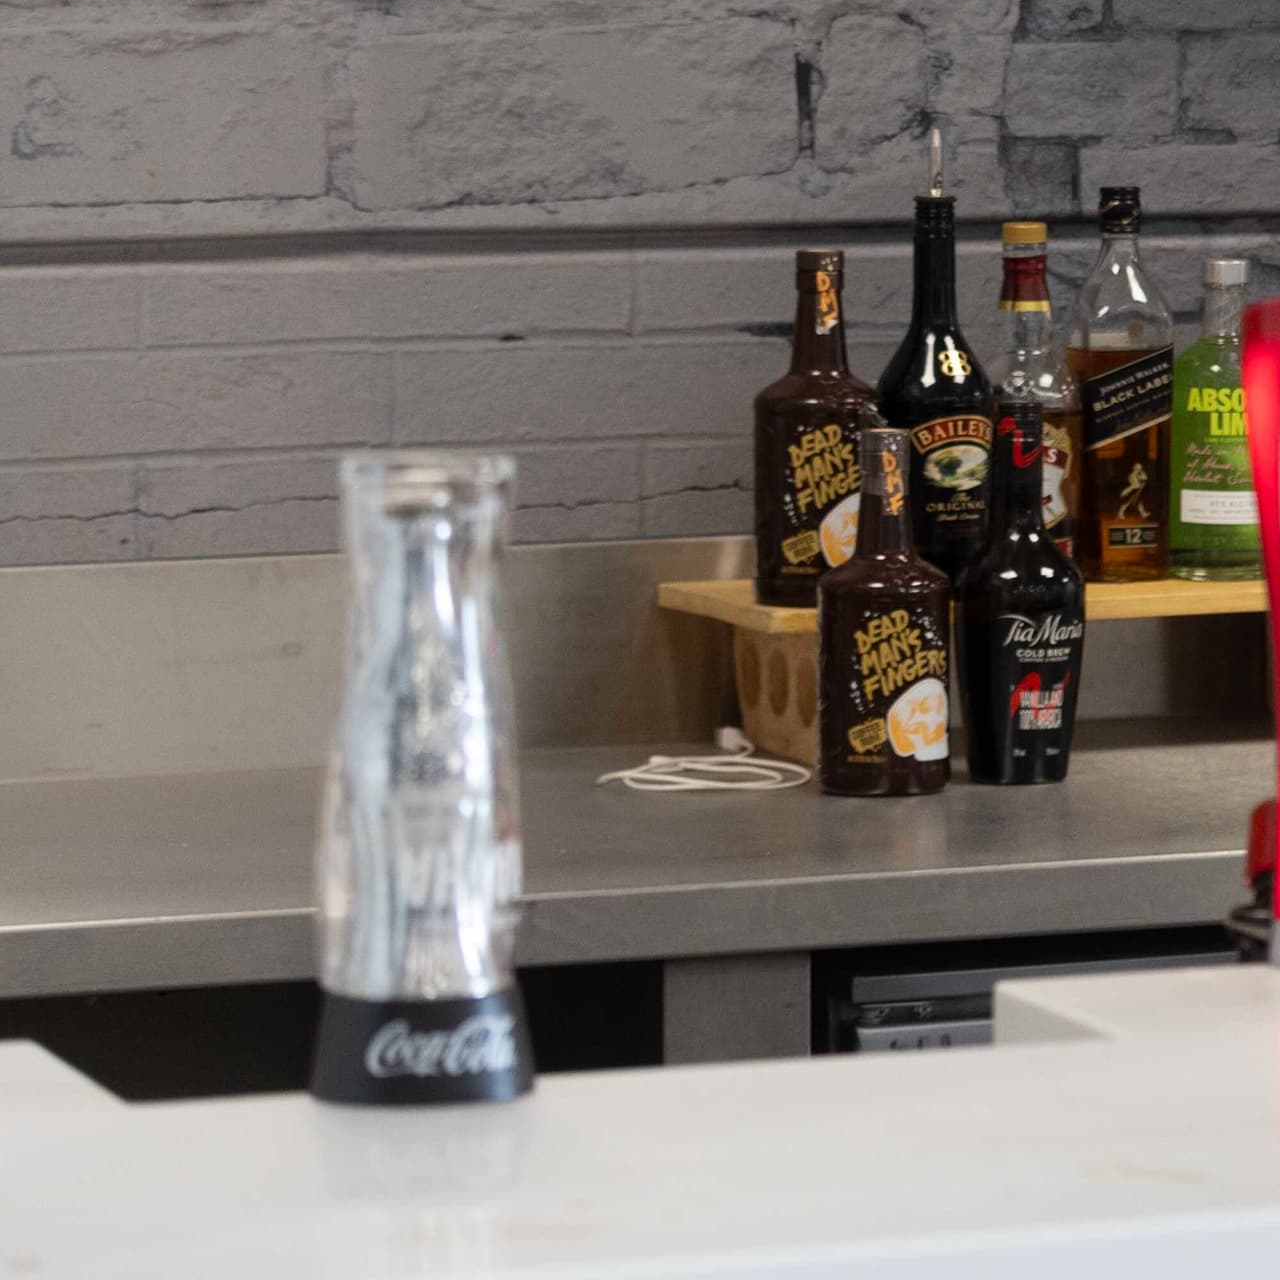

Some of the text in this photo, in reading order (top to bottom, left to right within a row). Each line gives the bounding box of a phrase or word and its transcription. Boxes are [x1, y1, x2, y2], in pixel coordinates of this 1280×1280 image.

[1093, 389, 1136, 411] BLACK
[788, 424, 842, 467] DEAD
[1125, 528, 1142, 544] 12
[854, 609, 910, 653] DEAD
[861, 628, 922, 675] MAN'S
[998, 614, 1037, 647] Tia
[864, 649, 947, 701] FINGERS
